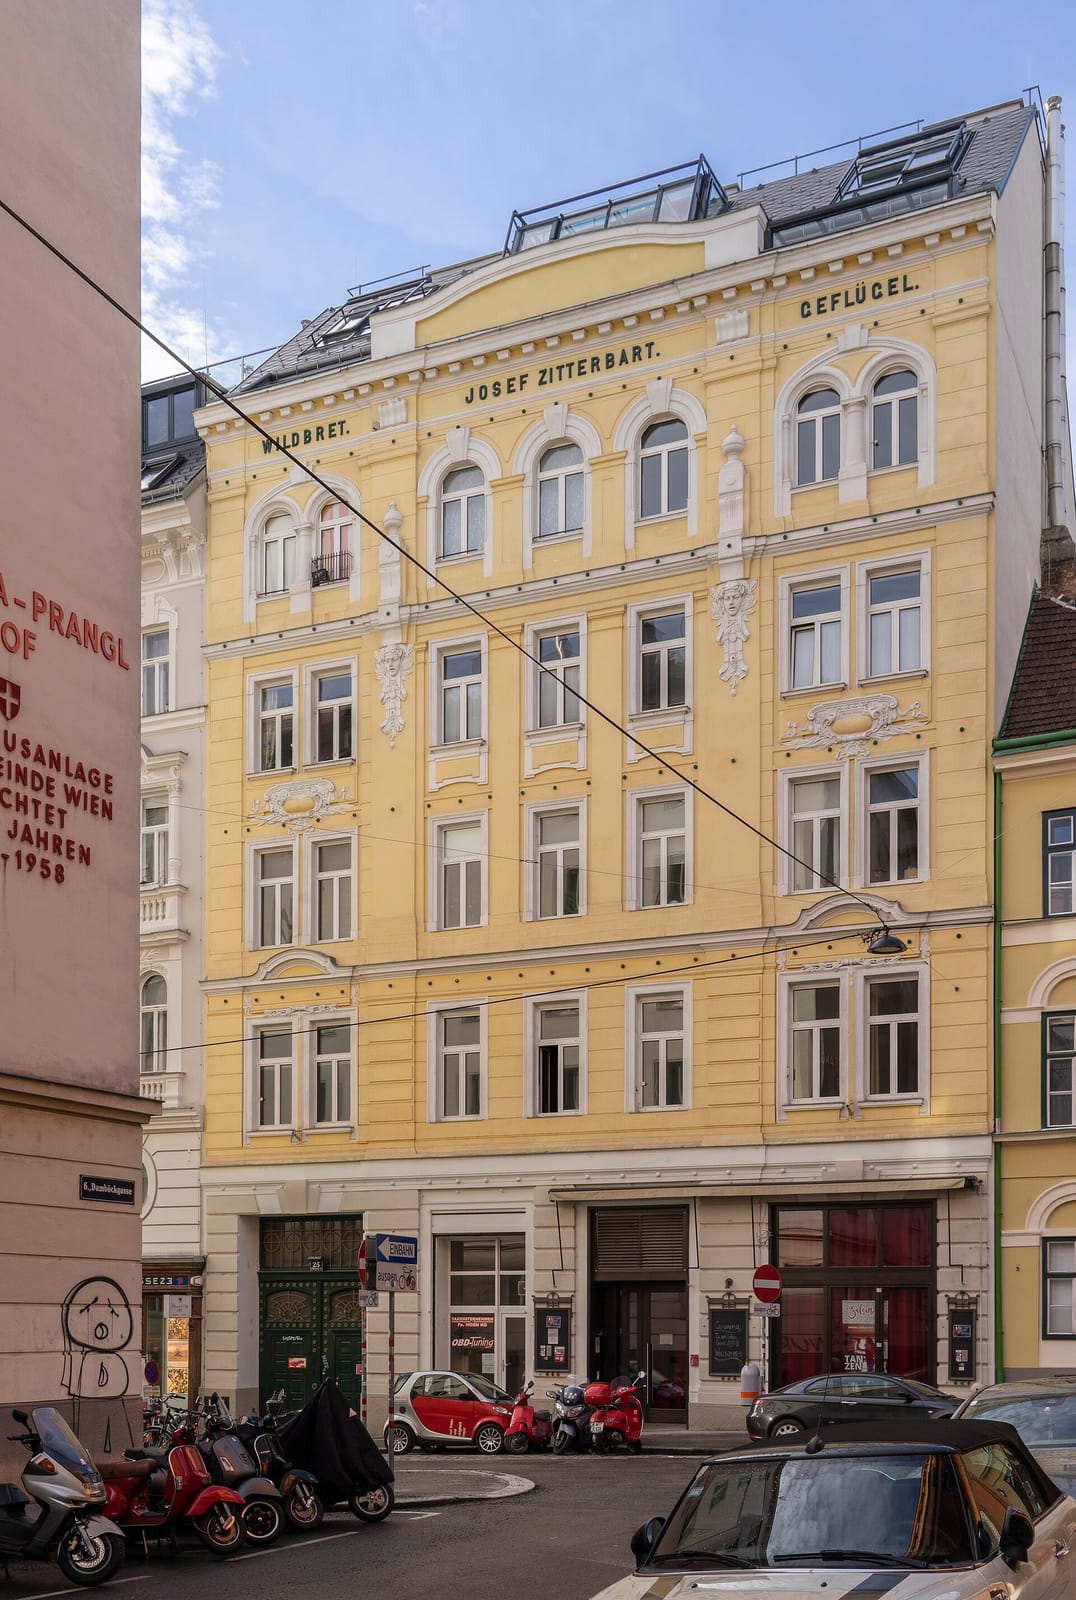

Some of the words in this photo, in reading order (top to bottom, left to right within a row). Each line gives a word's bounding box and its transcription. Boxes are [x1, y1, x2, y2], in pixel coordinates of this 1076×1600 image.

[800, 274, 920, 319] GEFLÜGEL.
[464, 373, 529, 404] JOSEF
[538, 341, 661, 386] ZITTERBART.
[261, 419, 350, 455] WILDBRET.
[3, 729, 113, 795] USANLAGE
[63, 783, 113, 821] WIEN
[7, 819, 91, 867] JAHREN
[312, 1261, 321, 1269] 25
[389, 1243, 414, 1257] EINBAHN
